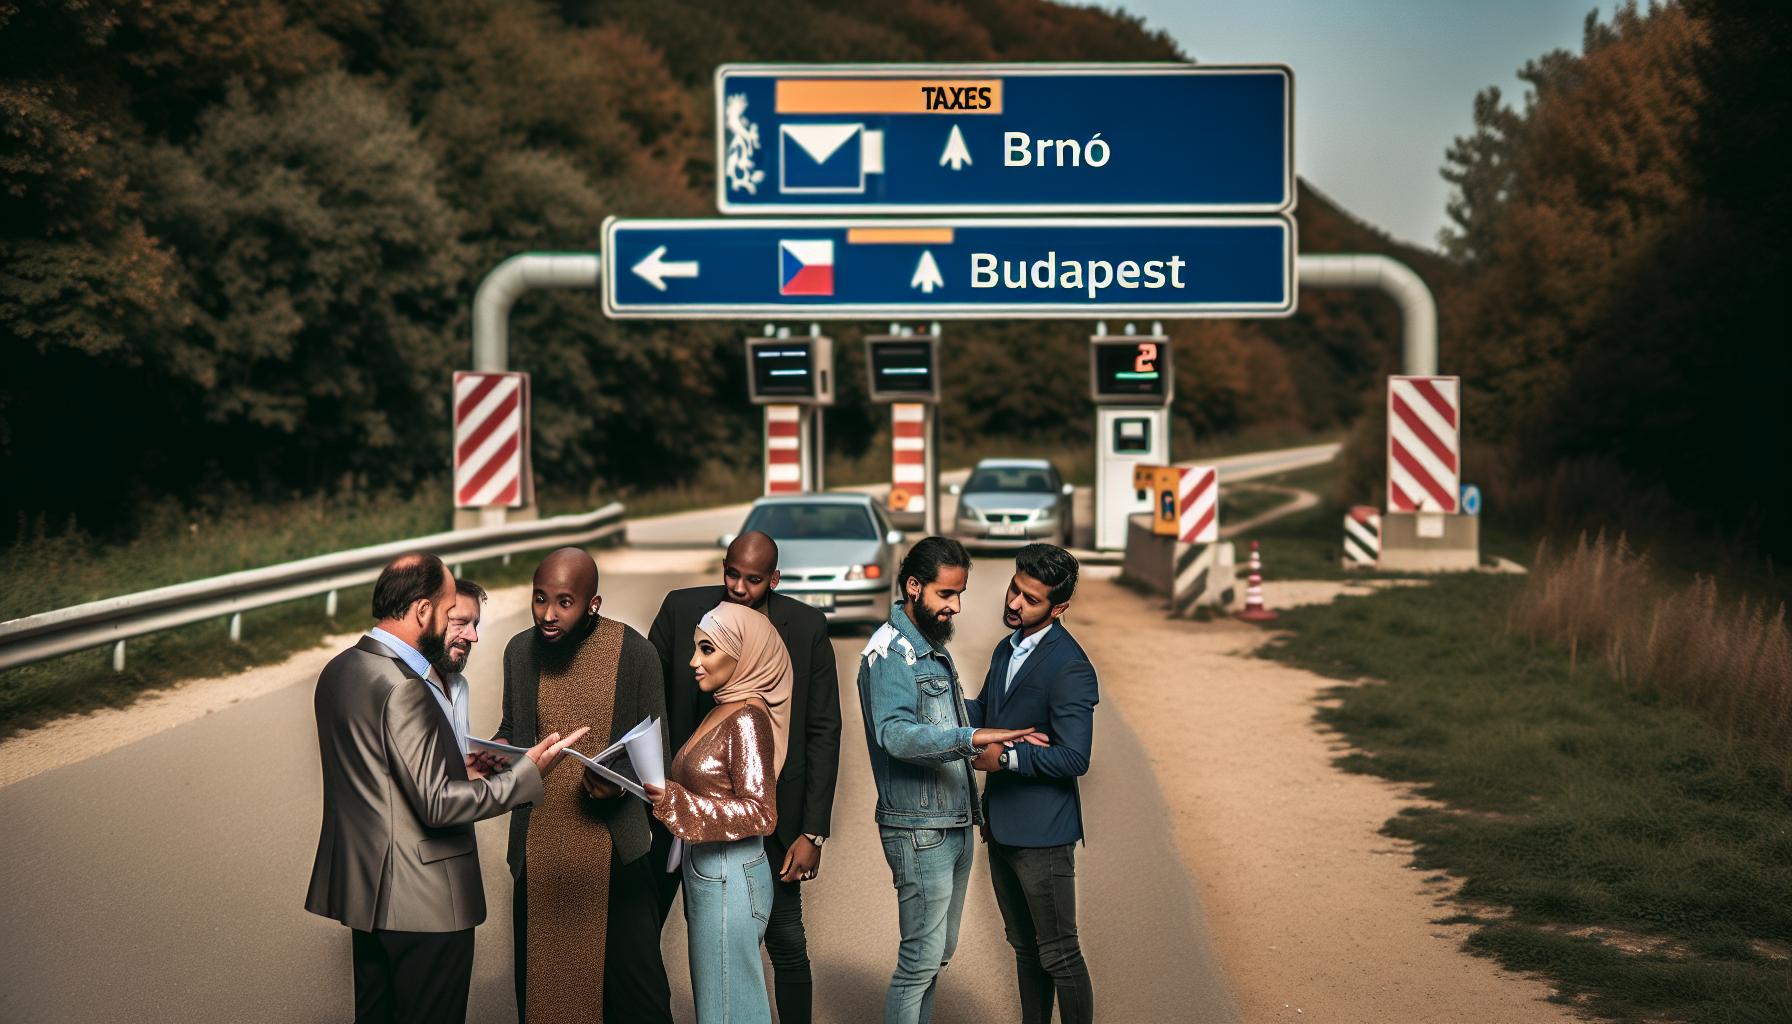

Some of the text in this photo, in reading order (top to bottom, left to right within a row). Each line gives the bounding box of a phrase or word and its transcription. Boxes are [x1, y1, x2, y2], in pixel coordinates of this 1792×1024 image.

[921, 86, 992, 110] TAXES
[1004, 131, 1111, 168] Brnó
[970, 251, 1186, 299] Budapest
